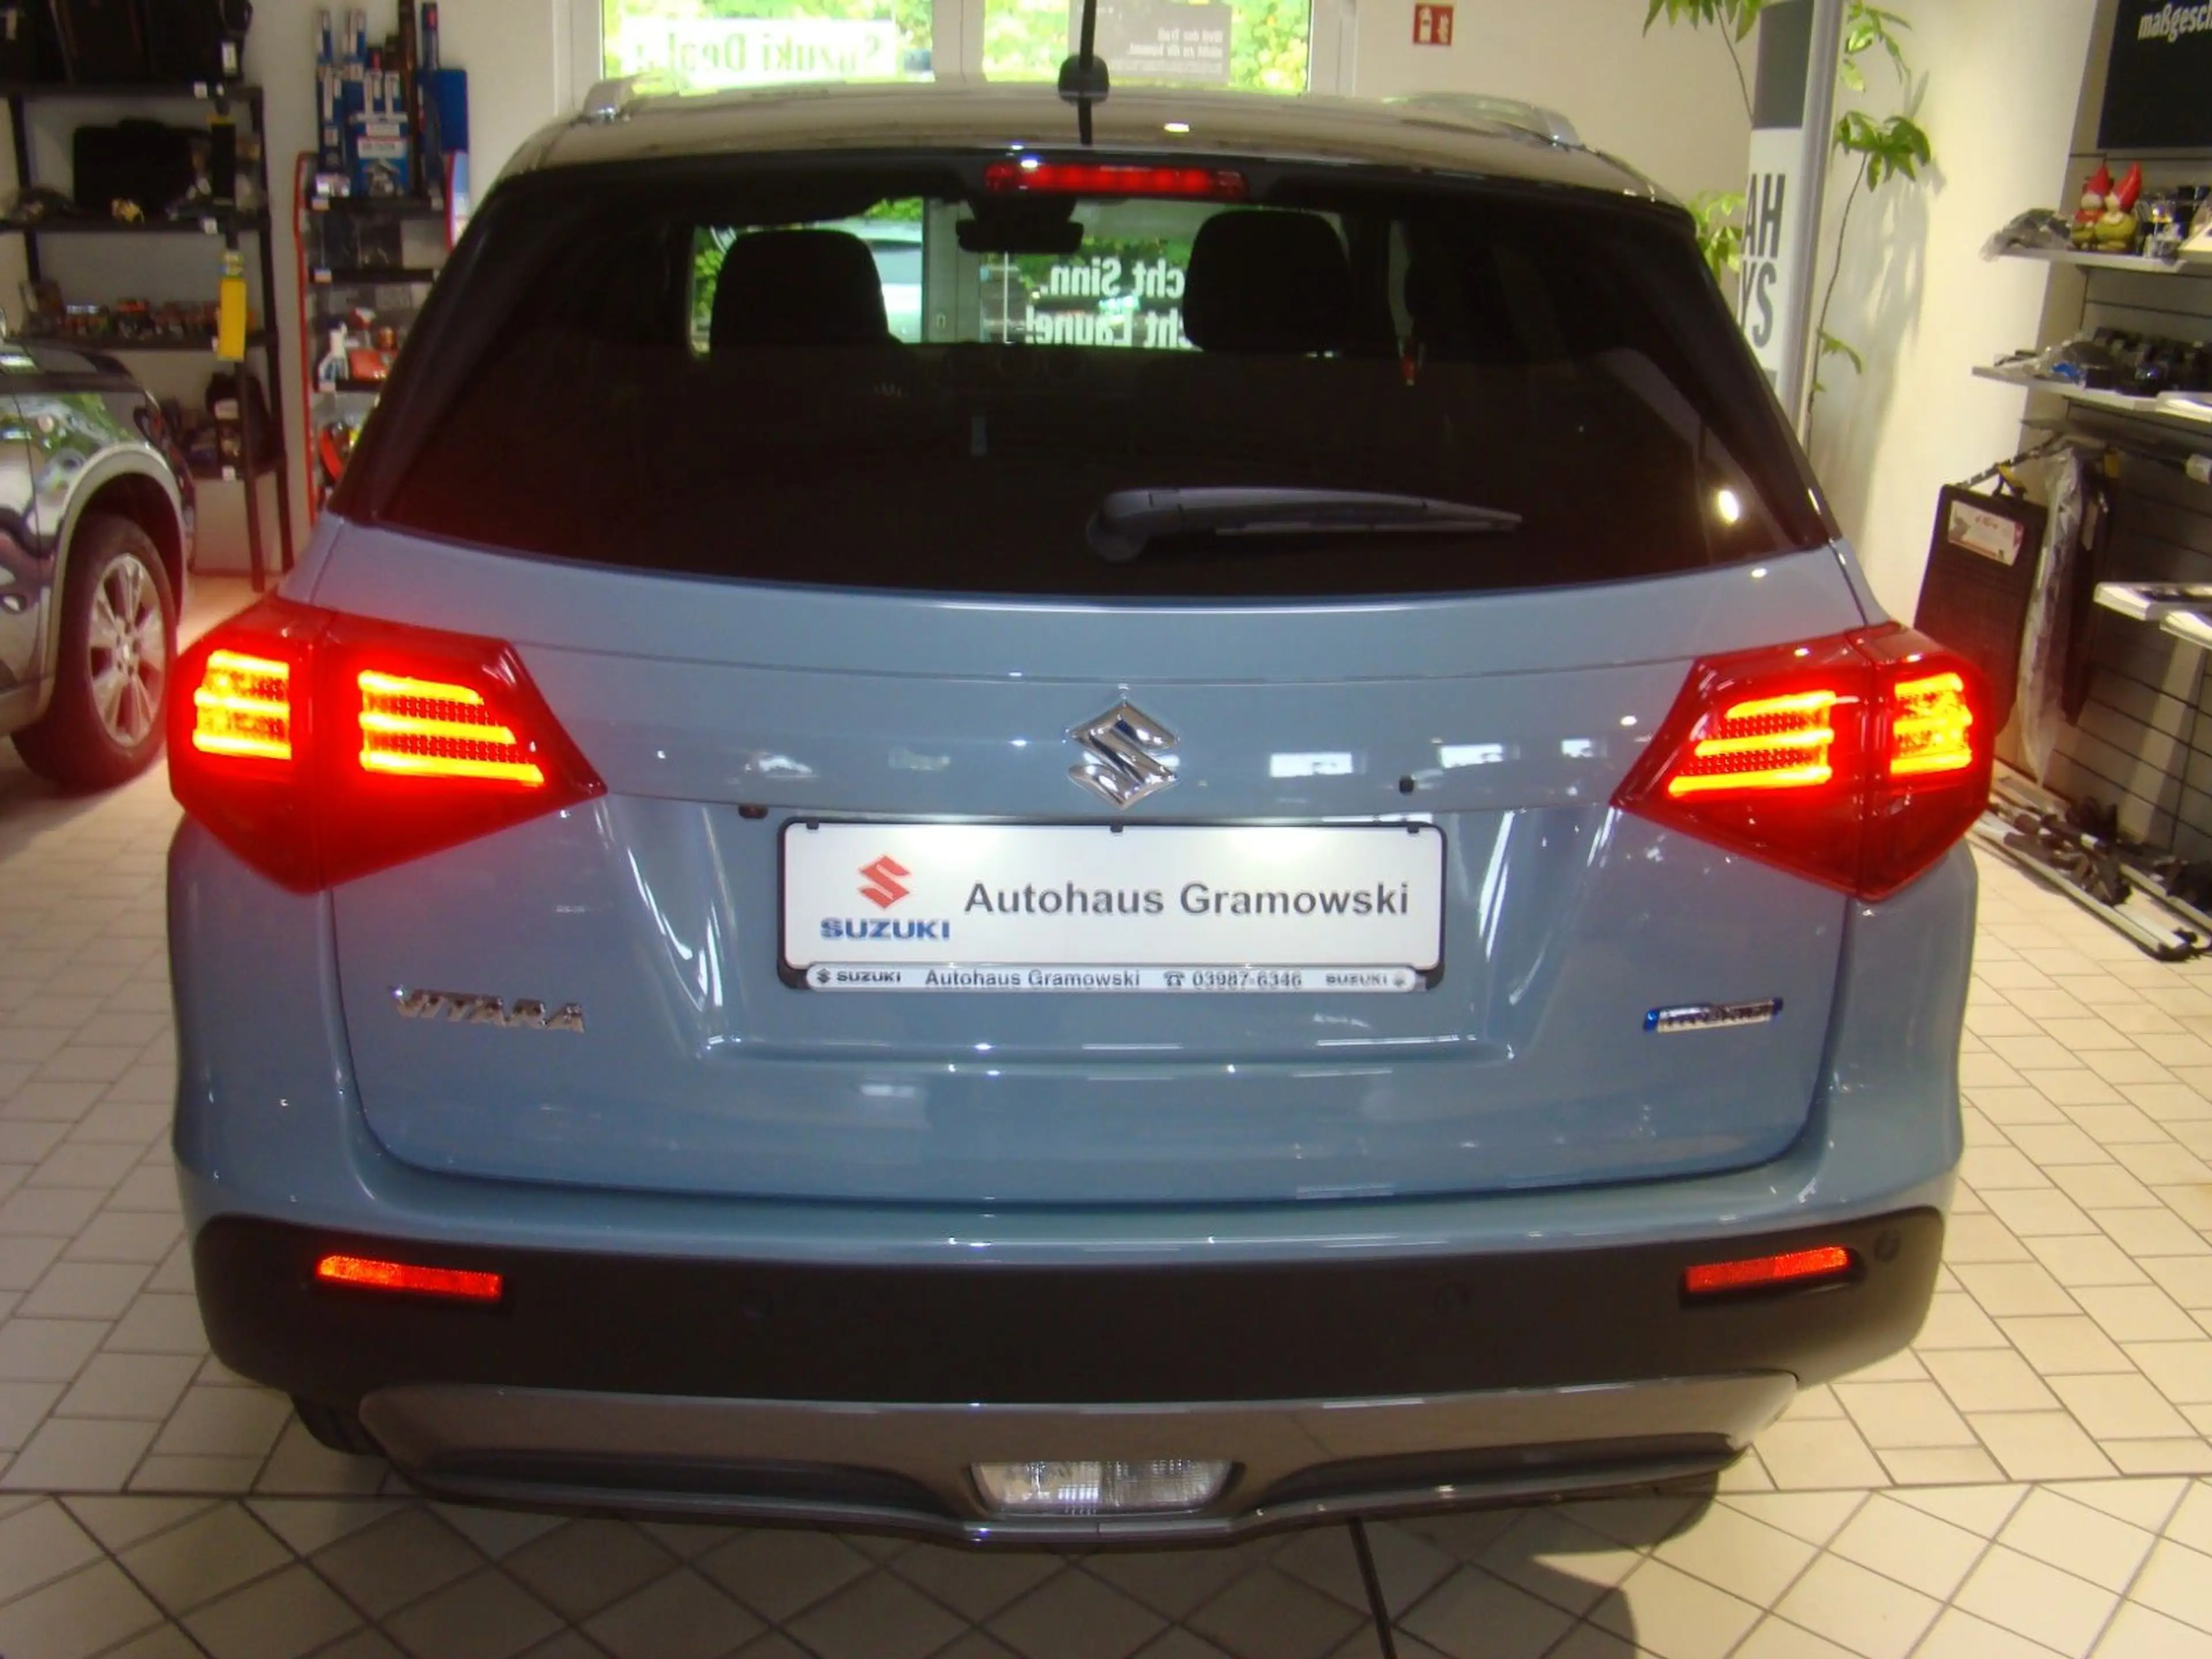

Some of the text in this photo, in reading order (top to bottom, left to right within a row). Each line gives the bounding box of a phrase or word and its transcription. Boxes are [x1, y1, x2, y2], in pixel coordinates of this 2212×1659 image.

[964, 881, 1410, 916] Autohaus Gramowski
[820, 918, 950, 942] SUZUKI
[836, 969, 1388, 990] SUZUKI Autohaus Gramowski 03987-6346 SUZUKI
